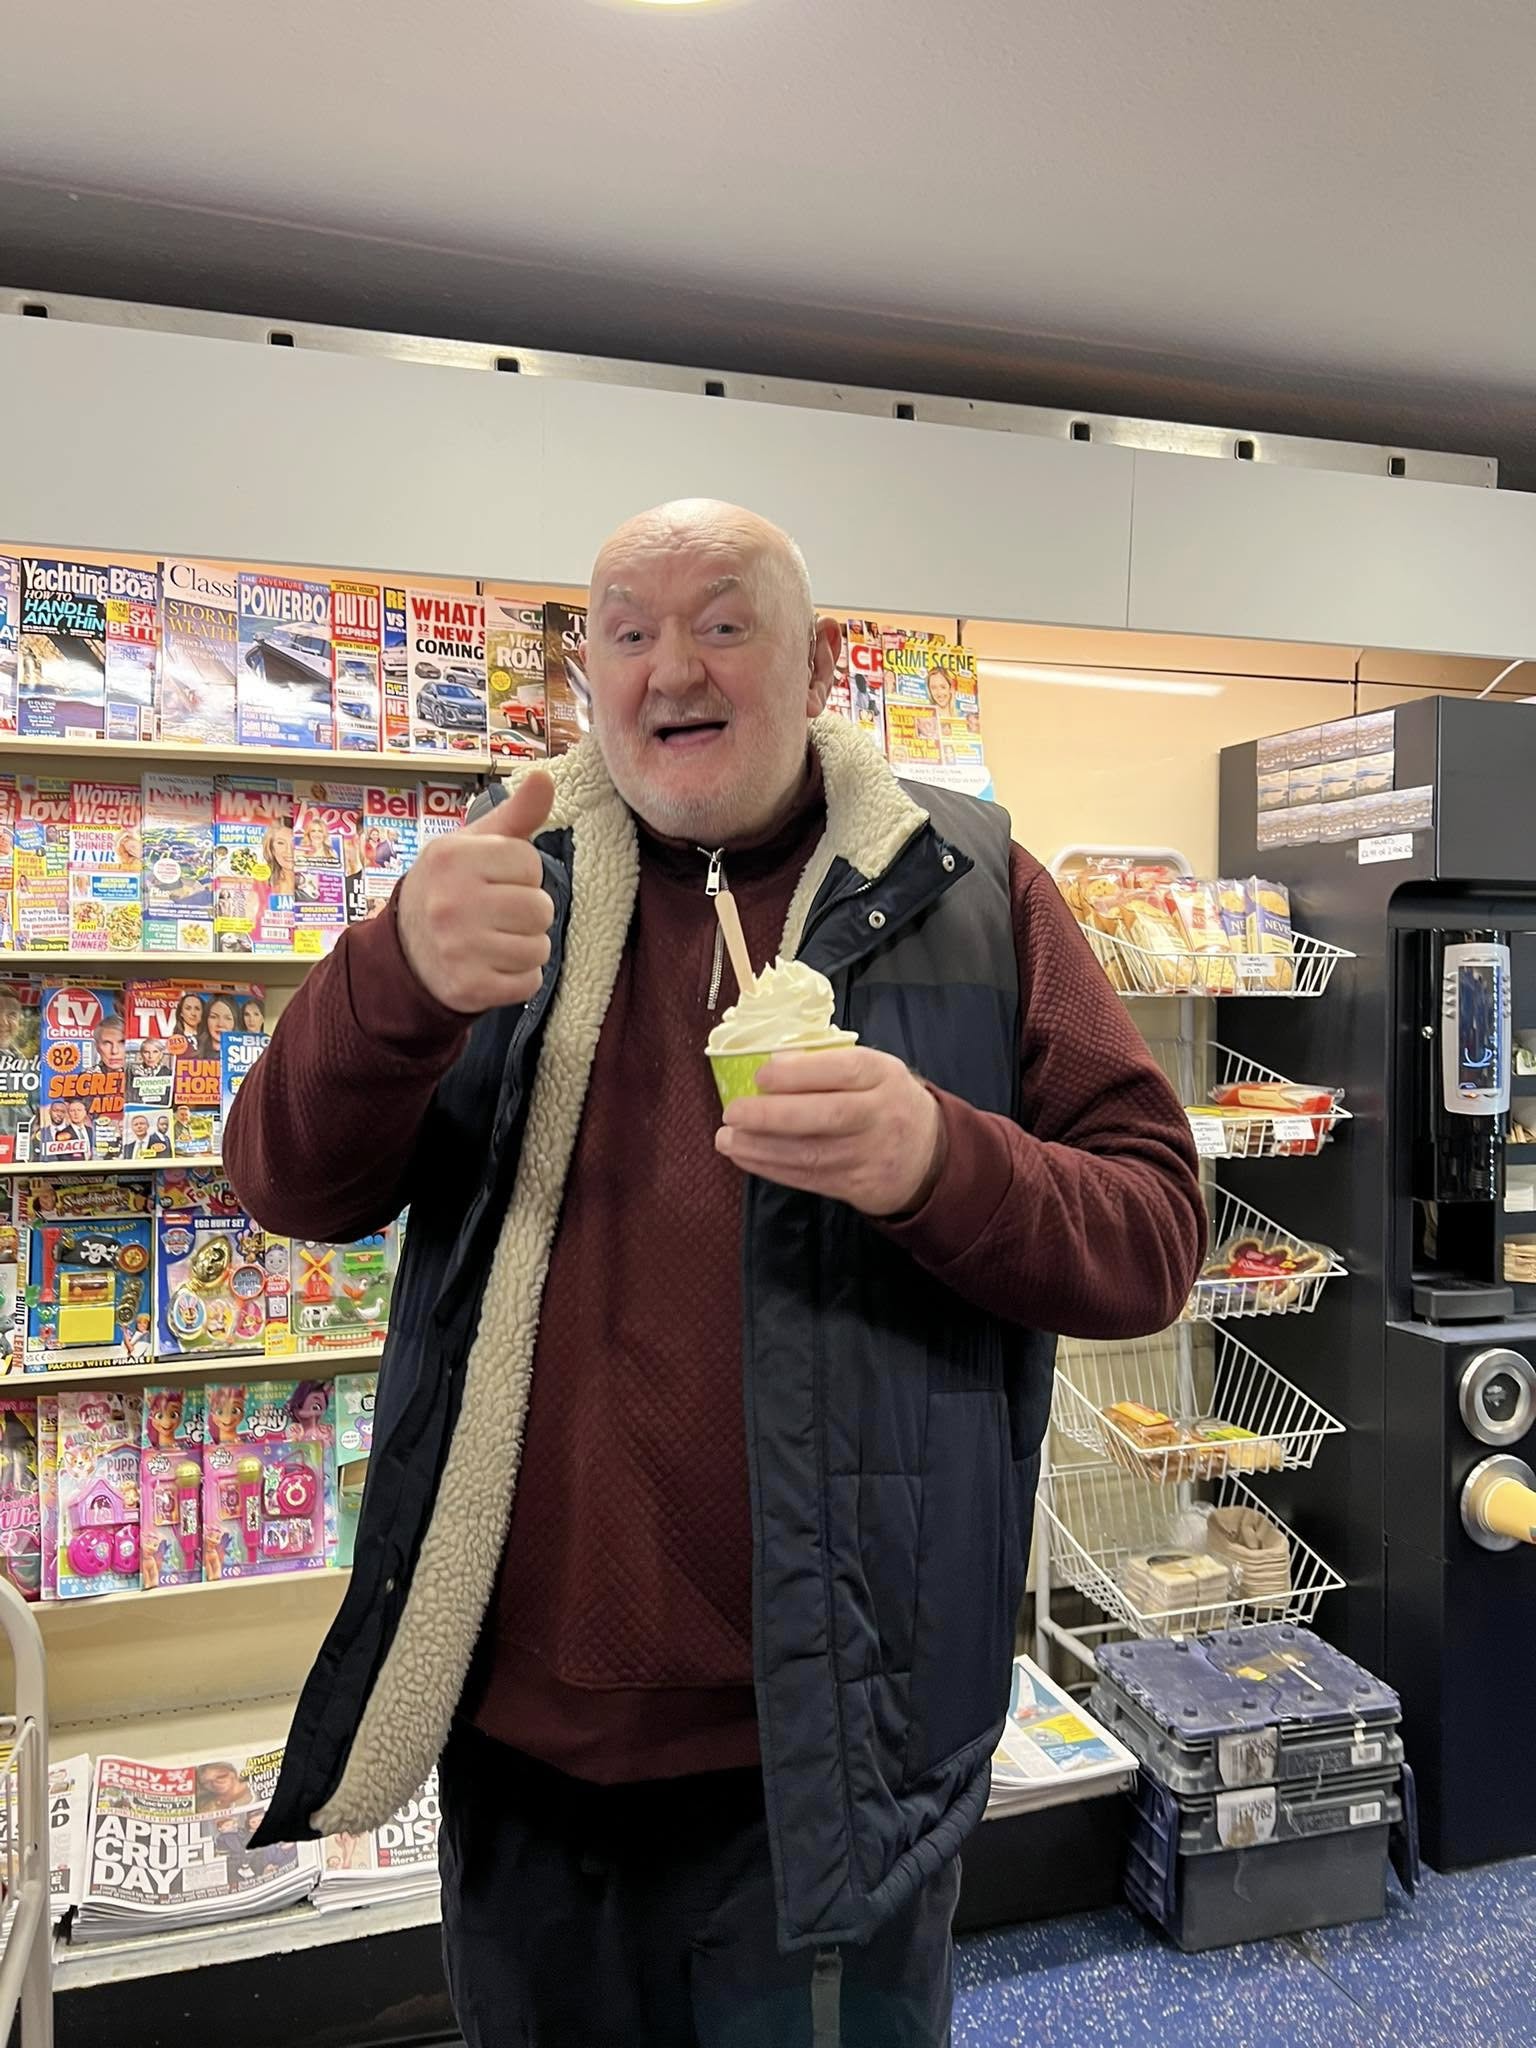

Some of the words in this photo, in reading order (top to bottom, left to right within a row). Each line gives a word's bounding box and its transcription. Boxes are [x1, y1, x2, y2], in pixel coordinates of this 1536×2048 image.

[22, 559, 109, 604] Yachting
[170, 564, 237, 600] Classi
[258, 578, 304, 590] ADVENTURE
[24, 590, 52, 600] HOW
[55, 592, 72, 602] TO
[24, 598, 97, 617] HANDLE
[335, 592, 378, 629] AUTO
[411, 597, 477, 626] WHAT
[335, 625, 379, 640] EXPRESS
[416, 623, 430, 633] 32
[433, 625, 473, 643] NEW
[416, 638, 485, 660] COMING
[885, 648, 929, 668] CRIME
[932, 652, 974, 673] SCENE
[73, 831, 114, 841] THICKER
[219, 824, 246, 834] HAPPY
[74, 841, 114, 850] SHINIER
[219, 834, 246, 843] HAPPY
[246, 835, 263, 844] YOU
[73, 850, 115, 862] HAIR
[71, 931, 108, 940] CHICKEN
[71, 940, 108, 950] DINNERS
[53, 994, 98, 1026] tv
[134, 998, 168, 1008] What's
[134, 1008, 177, 1038] TV
[11, 1073, 39, 1091] TO
[89, 1097, 124, 1114] AND
[48, 1141, 86, 1153] GRACE
[194, 1219, 210, 1229] EGG
[210, 1219, 231, 1228] HUNT
[231, 1219, 245, 1228] SET
[14, 1295, 26, 1325] BUILD
[11, 1334, 25, 1369] LEARN
[48, 1360, 84, 1371] PACKED
[86, 1359, 111, 1367] WITH
[247, 1415, 288, 1433] PONY
[107, 1457, 140, 1473] PUPPY
[246, 1748, 285, 1768] Andrew
[101, 1761, 162, 1783] Daily
[254, 1771, 273, 1783] will
[100, 1771, 194, 1792] Record
[96, 1814, 214, 1847] APRIL
[94, 1837, 228, 1870] CRUEL
[93, 1860, 181, 1894] DAY
